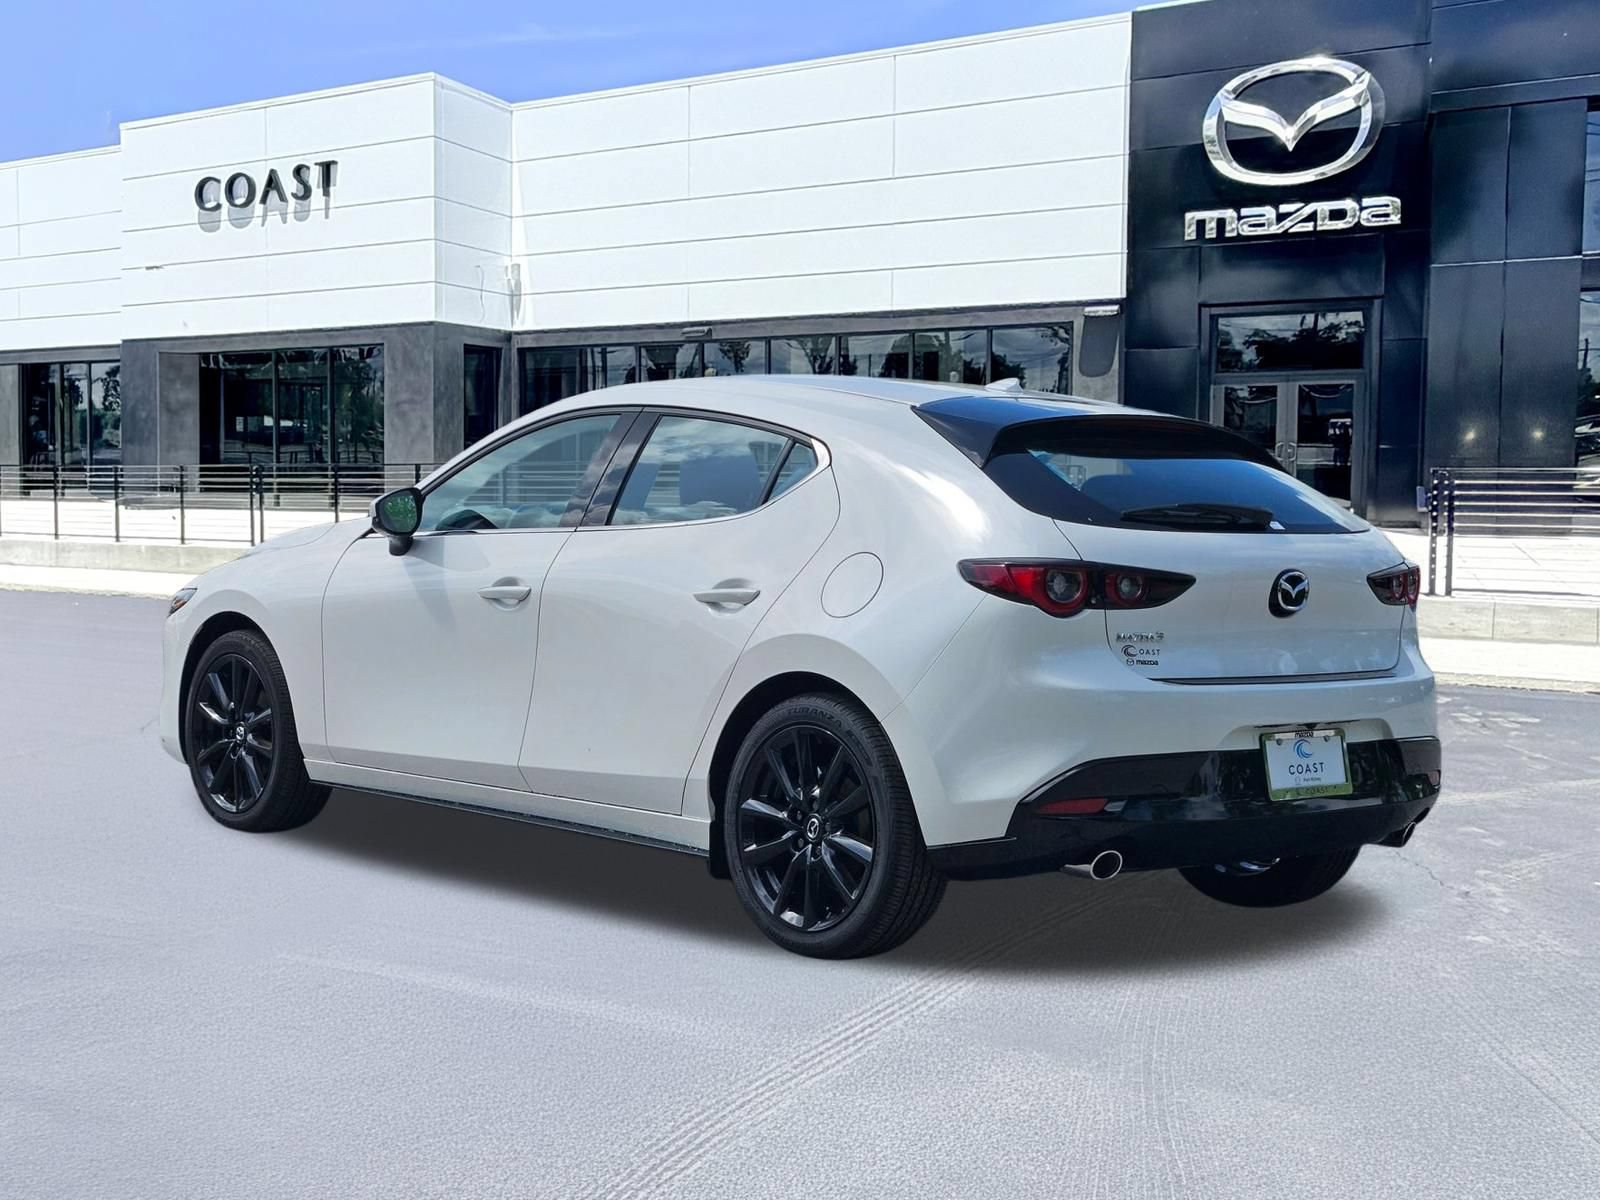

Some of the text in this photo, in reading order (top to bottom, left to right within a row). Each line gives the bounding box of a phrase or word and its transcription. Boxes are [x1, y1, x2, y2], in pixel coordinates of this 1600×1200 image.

[194, 160, 338, 212] COAST
[1184, 196, 1402, 241] mazda
[1288, 762, 1325, 775] COAST
